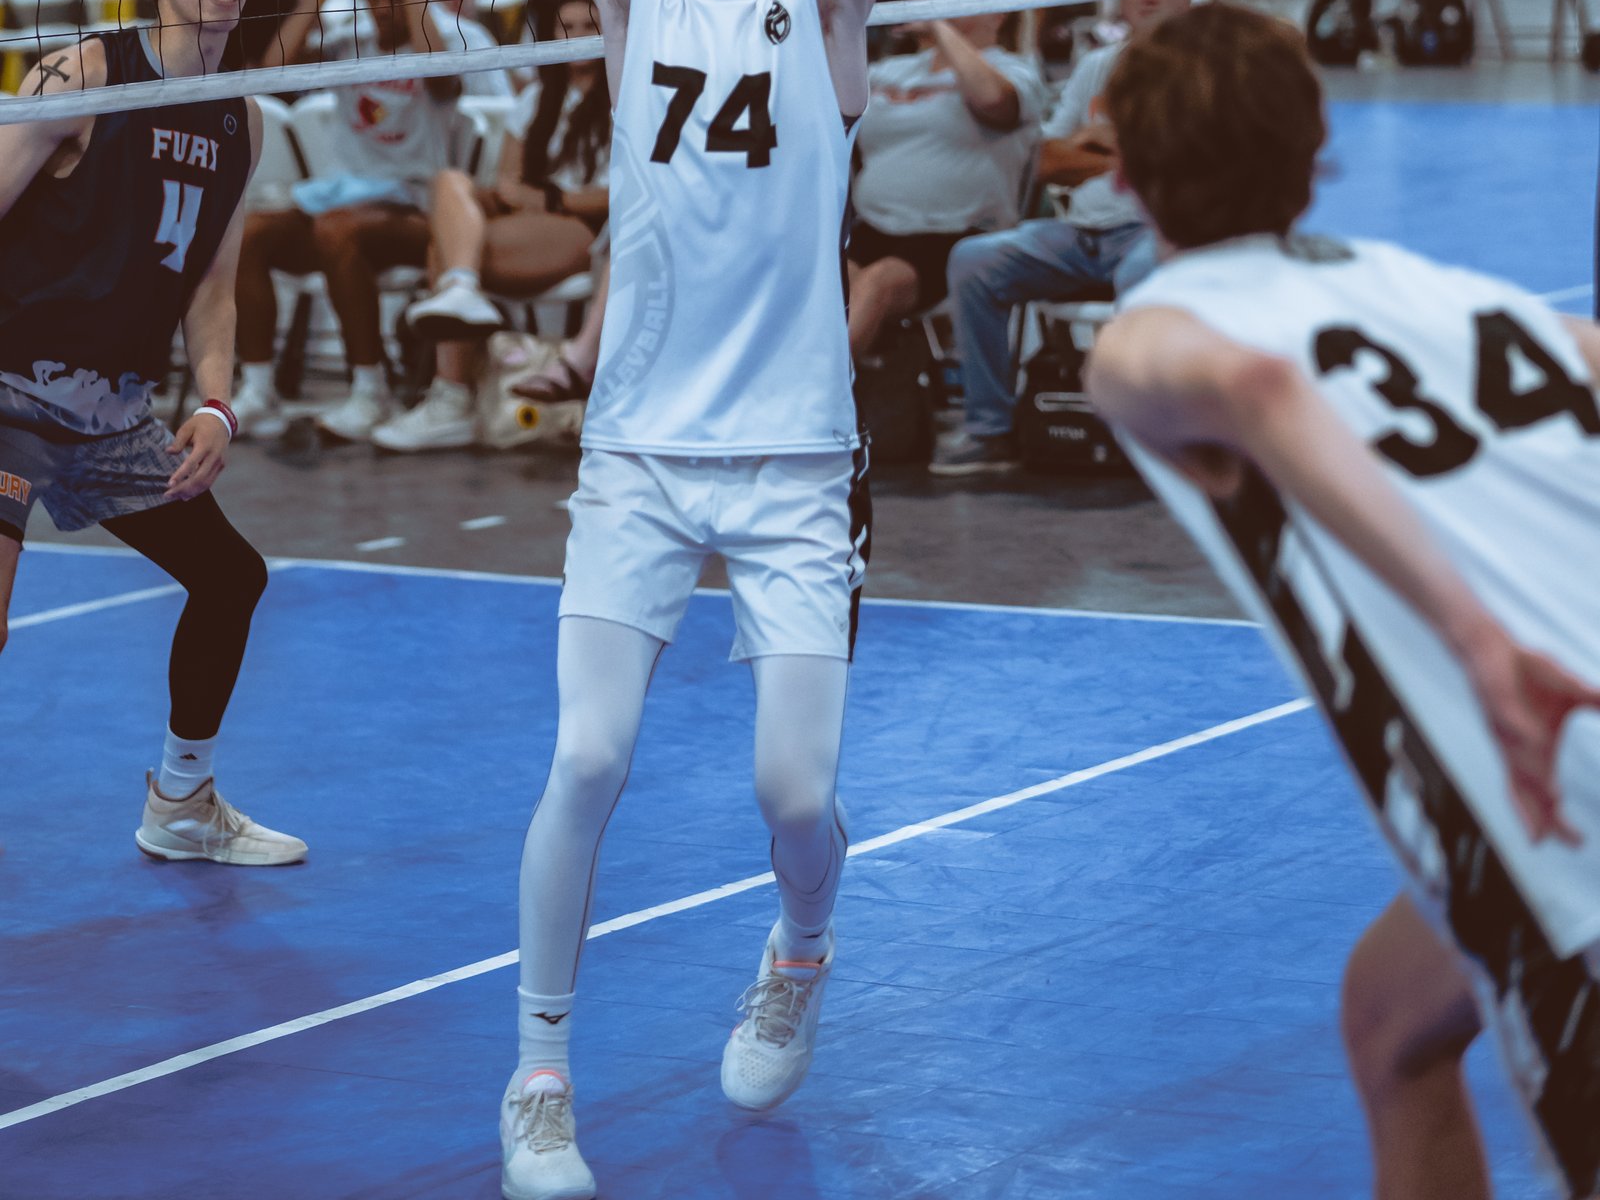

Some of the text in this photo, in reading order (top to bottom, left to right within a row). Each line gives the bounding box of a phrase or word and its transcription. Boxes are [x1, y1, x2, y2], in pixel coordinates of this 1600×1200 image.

[151, 126, 219, 173] FURY
[650, 60, 778, 169] 74
[1312, 307, 1600, 478] 34
